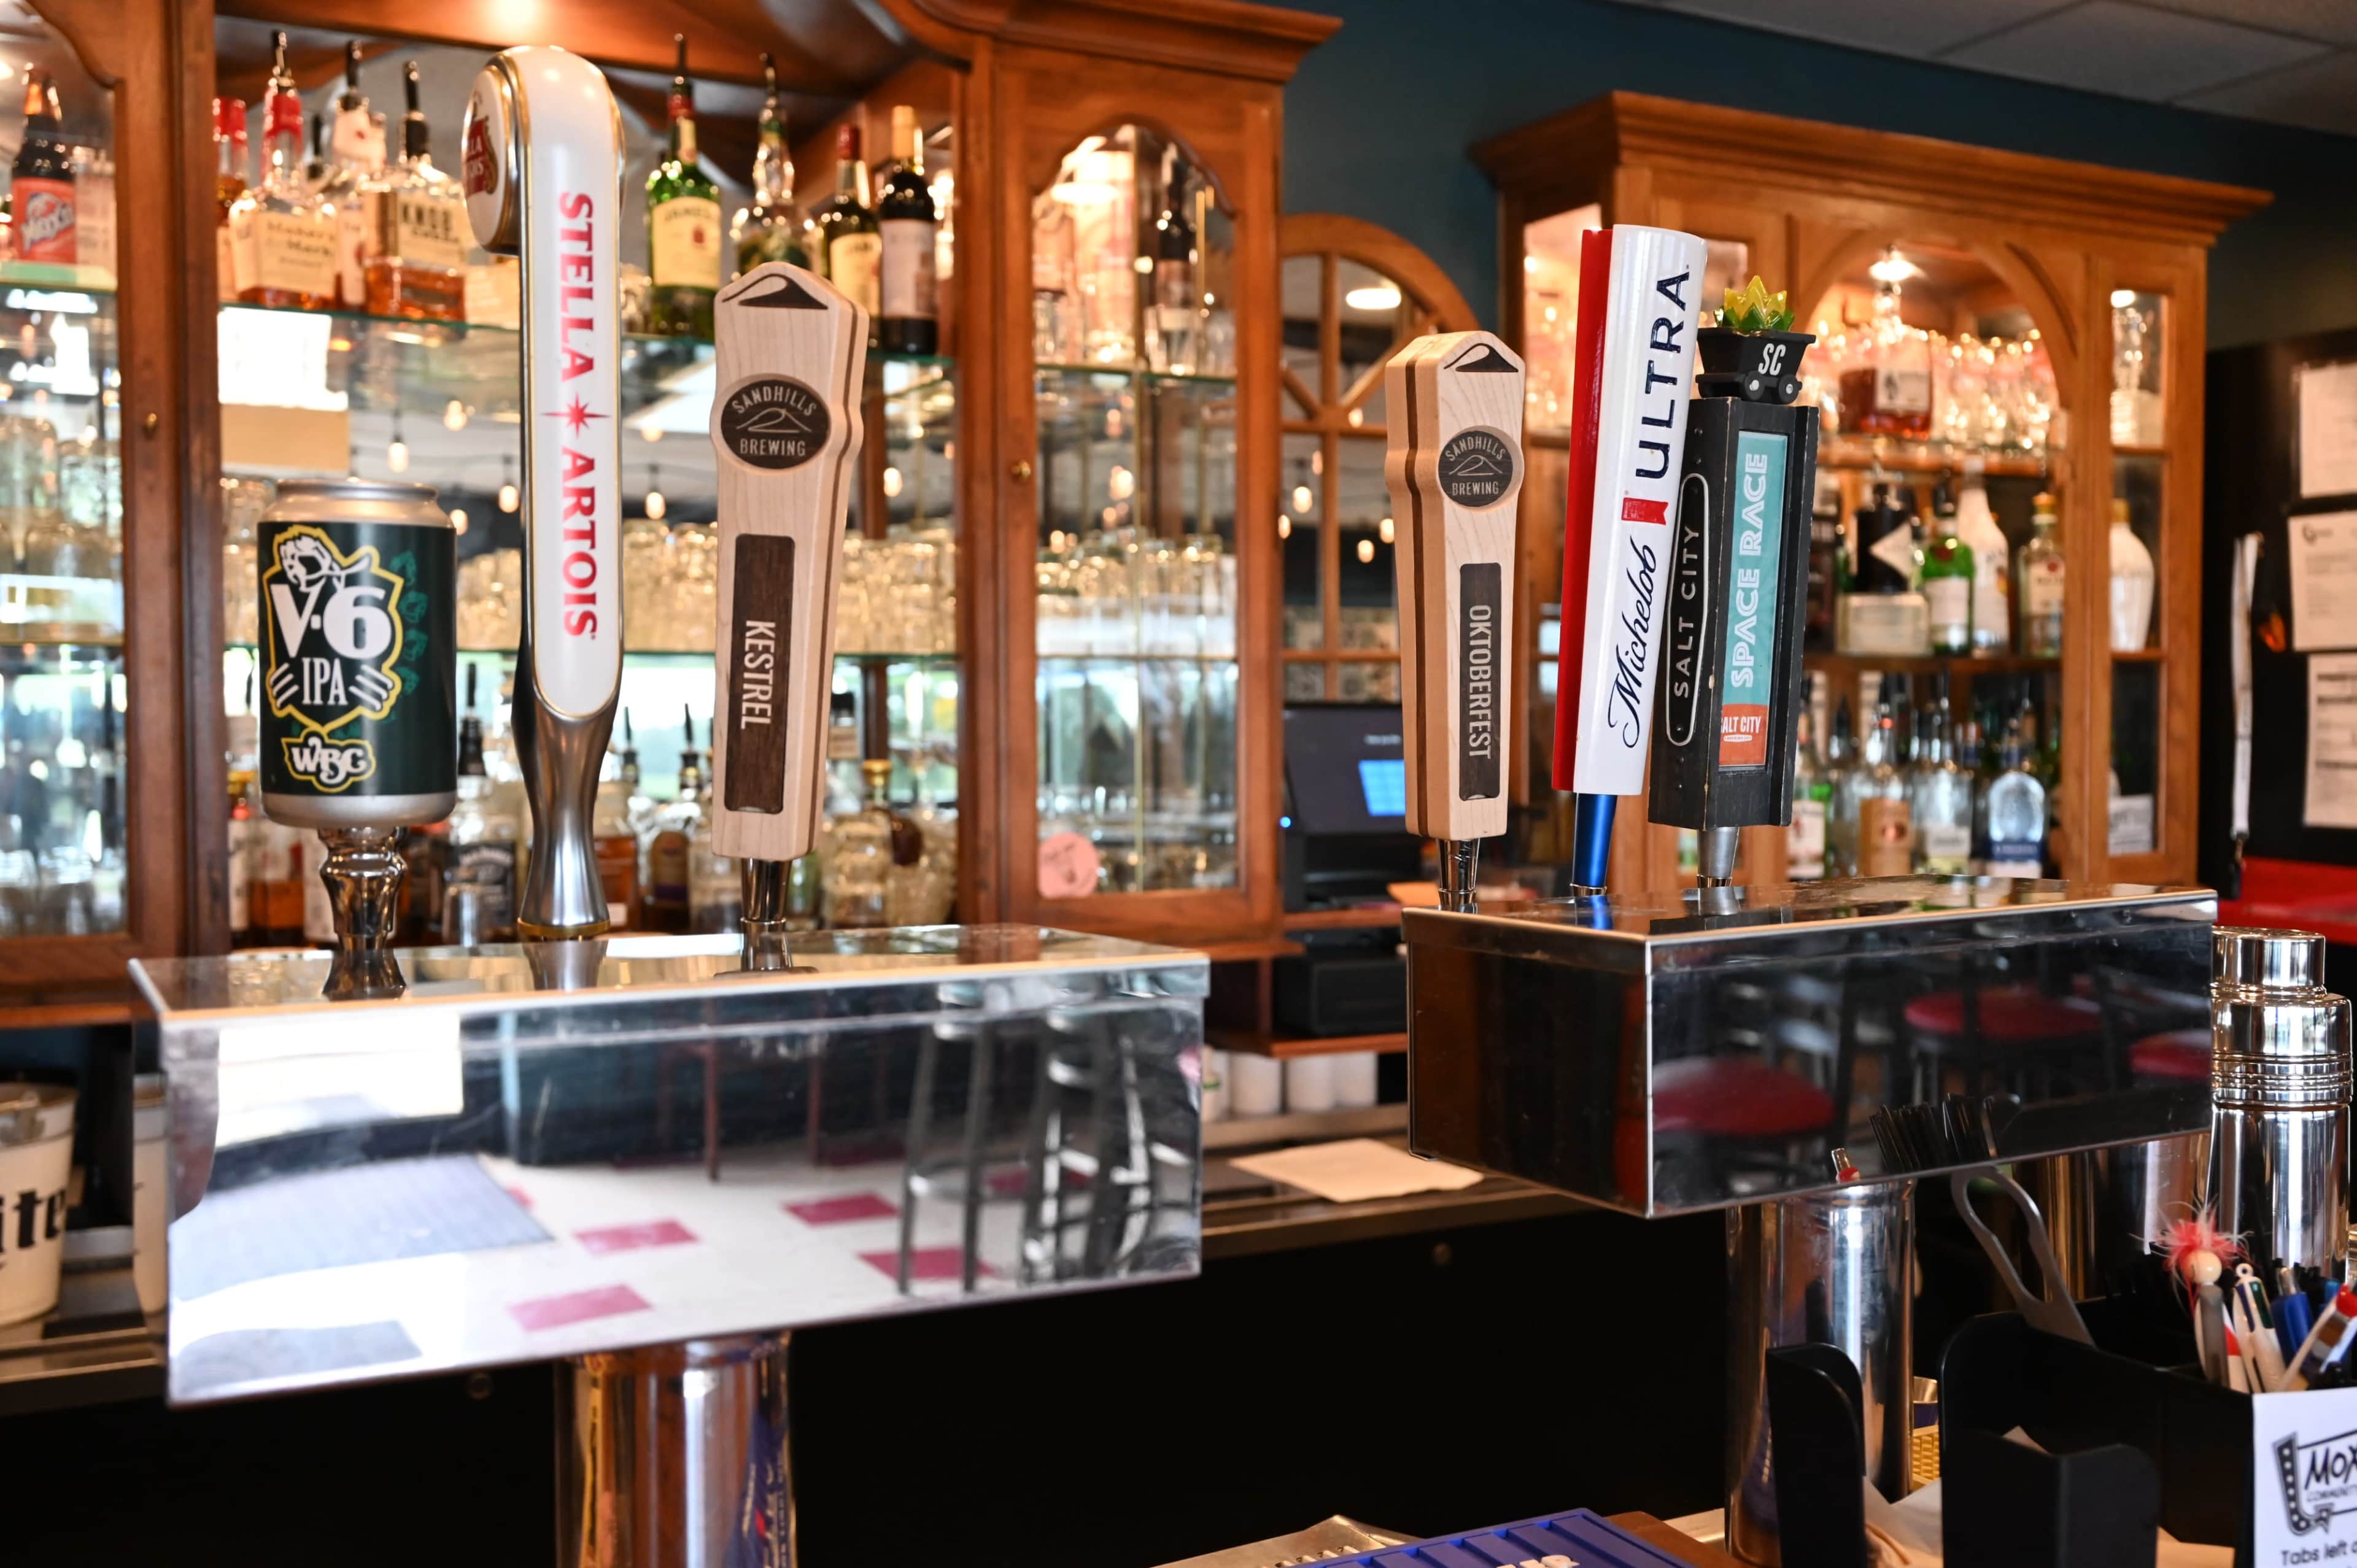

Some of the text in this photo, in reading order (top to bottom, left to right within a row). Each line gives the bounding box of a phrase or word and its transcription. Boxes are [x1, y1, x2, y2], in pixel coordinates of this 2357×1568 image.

[1636, 271, 1690, 479] ULTRA
[1758, 343, 1786, 376] SC
[559, 191, 598, 639] STELLA ARTOIS
[732, 385, 817, 416] SANDHILLS
[740, 438, 806, 457] BREWING
[1445, 435, 1507, 462] SANDHILLS
[1452, 481, 1500, 496] BREWING
[1730, 453, 1768, 689] SPACE RACE
[1673, 526, 1699, 698] SALT CITY
[1608, 535, 1657, 749] Michelob
[301, 657, 349, 706] IPA
[740, 620, 776, 730] KESTREL
[1469, 604, 1492, 760] OKTOBERFEST
[1740, 716, 1762, 733] CITY
[291, 736, 366, 785] WBC
[2282, 1548, 2320, 1566] Tabs
[2324, 1540, 2347, 1560] left
